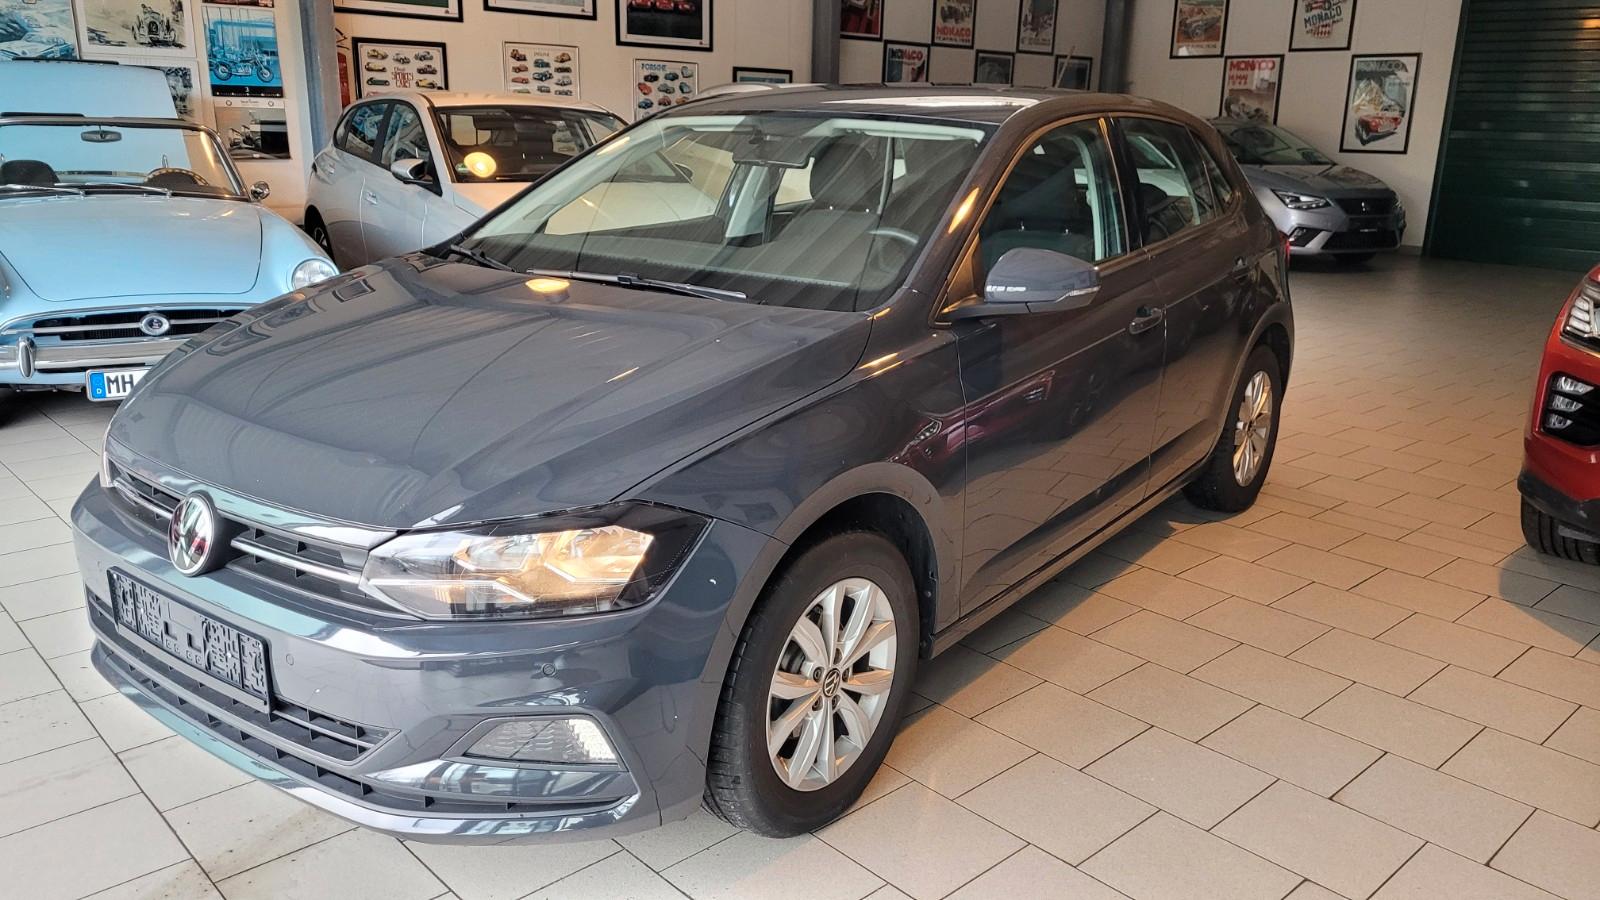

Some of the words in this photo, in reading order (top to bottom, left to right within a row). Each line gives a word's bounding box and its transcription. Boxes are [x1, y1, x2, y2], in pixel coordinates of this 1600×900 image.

[1304, 5, 1342, 28] MONACO
[937, 25, 971, 38] MONACO
[889, 47, 923, 61] MONACO
[106, 374, 135, 394] MH
